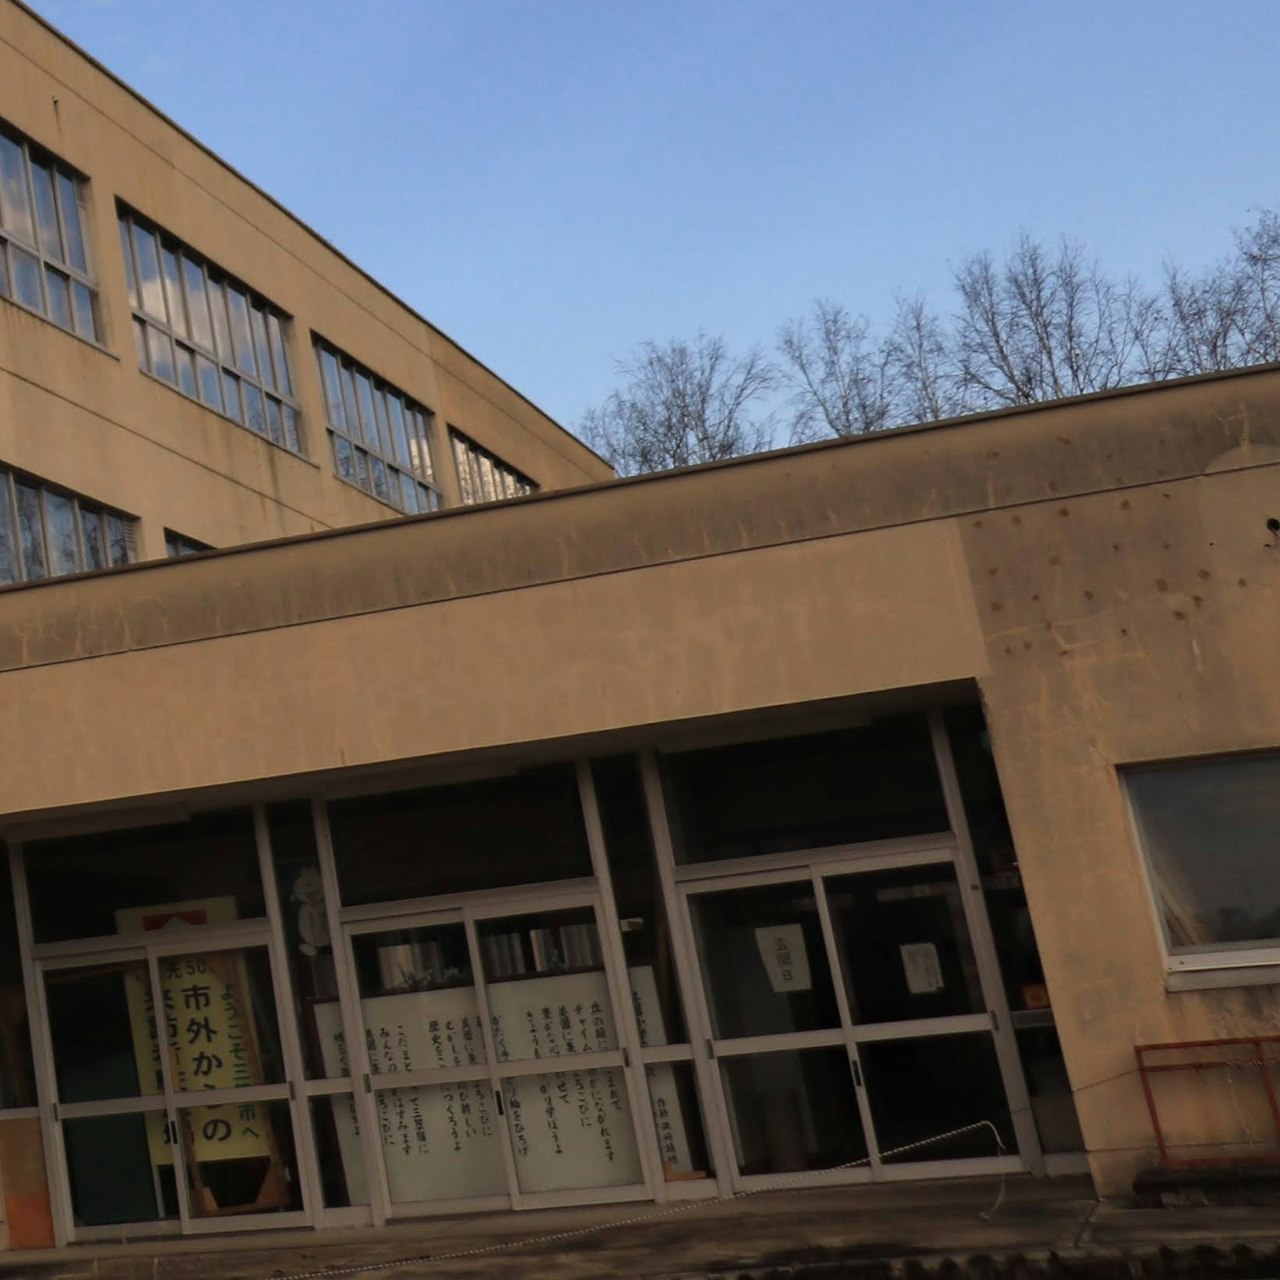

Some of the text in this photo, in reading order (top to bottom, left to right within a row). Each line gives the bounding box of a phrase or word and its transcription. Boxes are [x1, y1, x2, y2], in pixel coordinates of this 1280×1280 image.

[221, 983, 261, 1139] ようこそ三市へ
